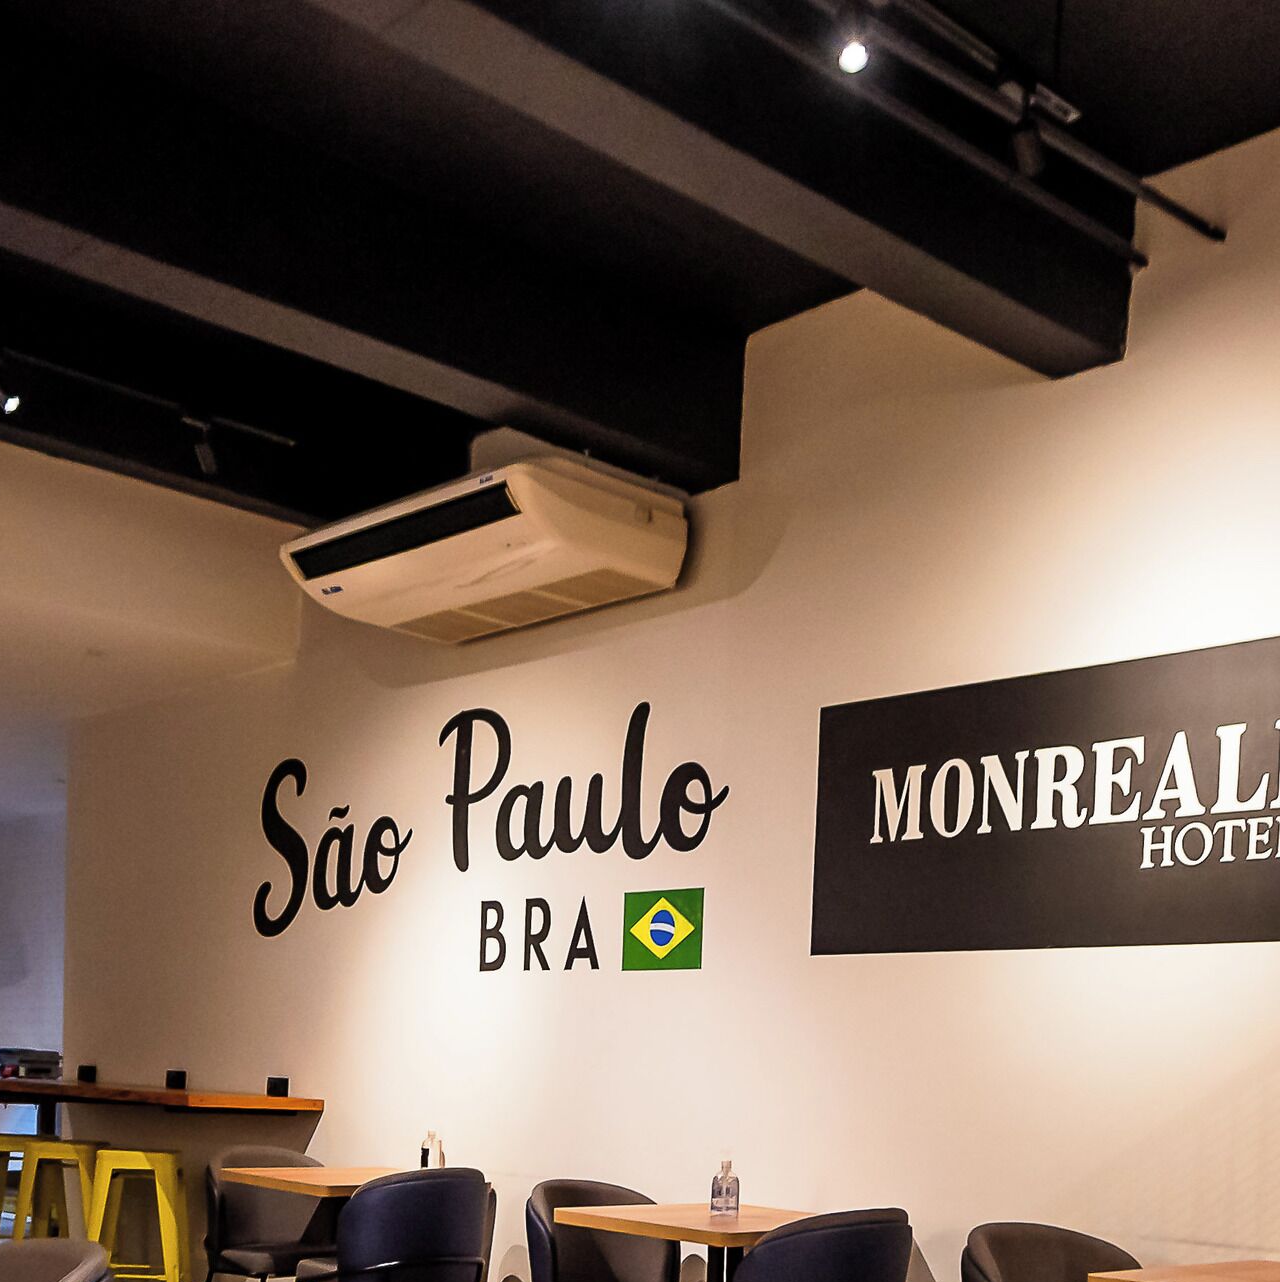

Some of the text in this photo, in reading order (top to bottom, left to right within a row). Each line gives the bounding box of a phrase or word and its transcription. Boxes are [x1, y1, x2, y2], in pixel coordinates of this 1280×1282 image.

[252, 701, 730, 938] São Paulo
[479, 895, 600, 972] BRA
